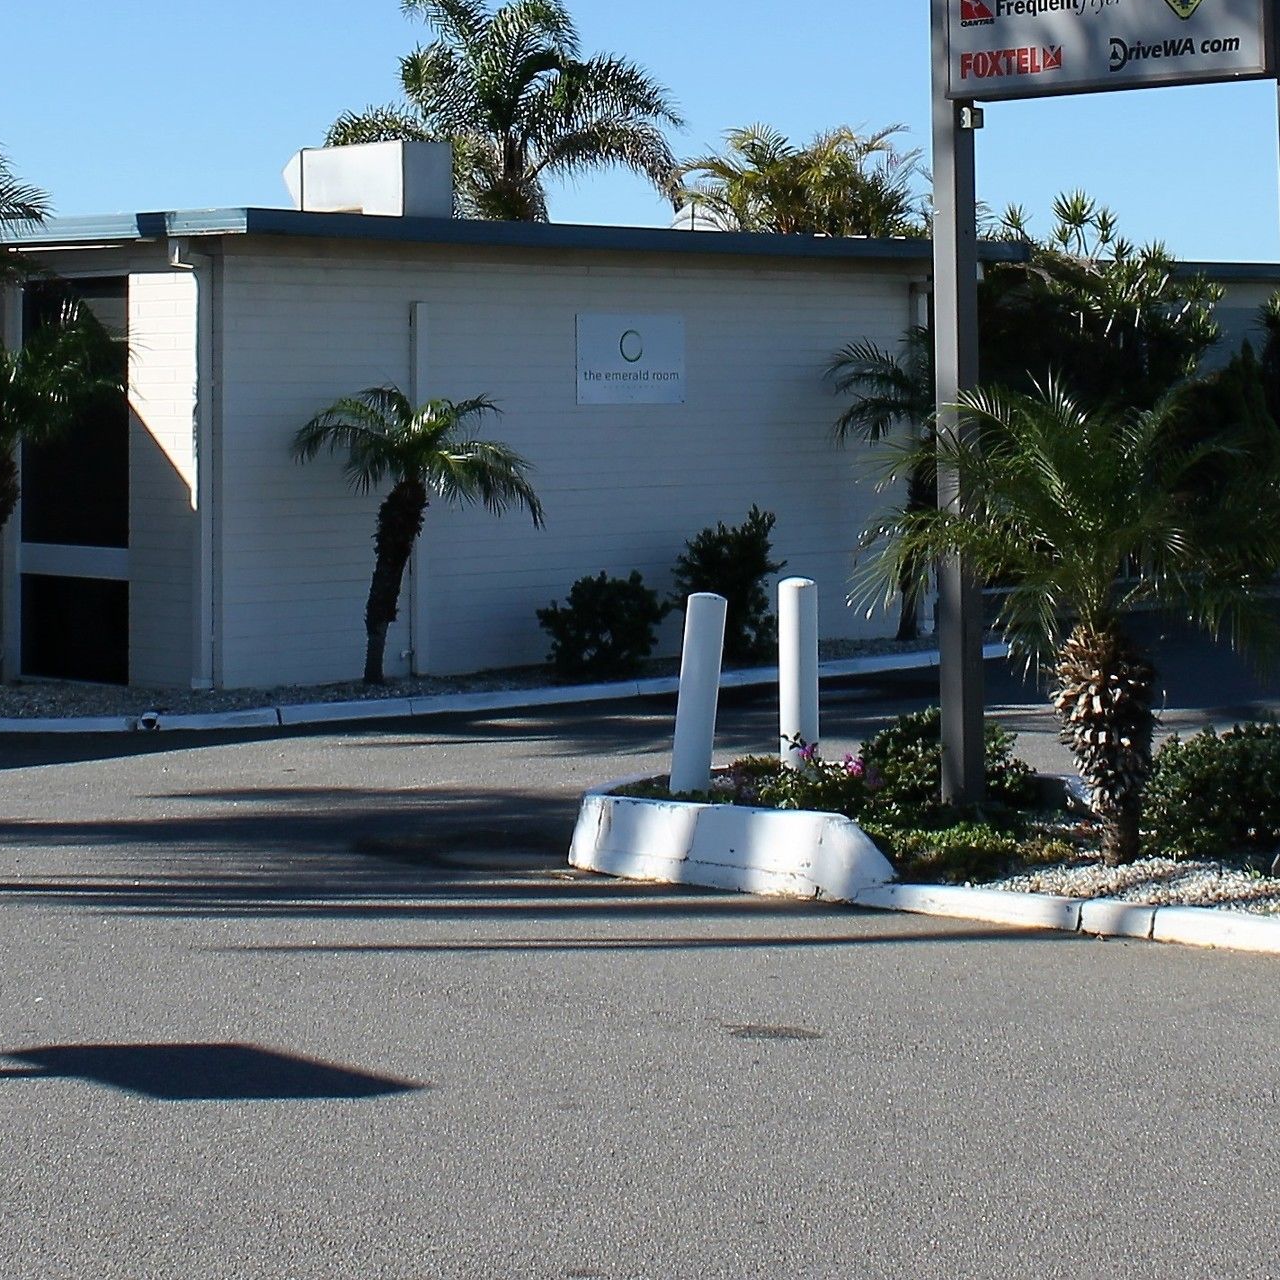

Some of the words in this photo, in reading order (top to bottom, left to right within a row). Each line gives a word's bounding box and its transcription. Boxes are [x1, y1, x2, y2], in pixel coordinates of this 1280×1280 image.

[960, 18, 995, 28] QANTAS
[960, 47, 1041, 80] FOXTEL
[584, 370, 602, 381] the
[605, 370, 649, 381] emerald
[652, 371, 680, 382] room
